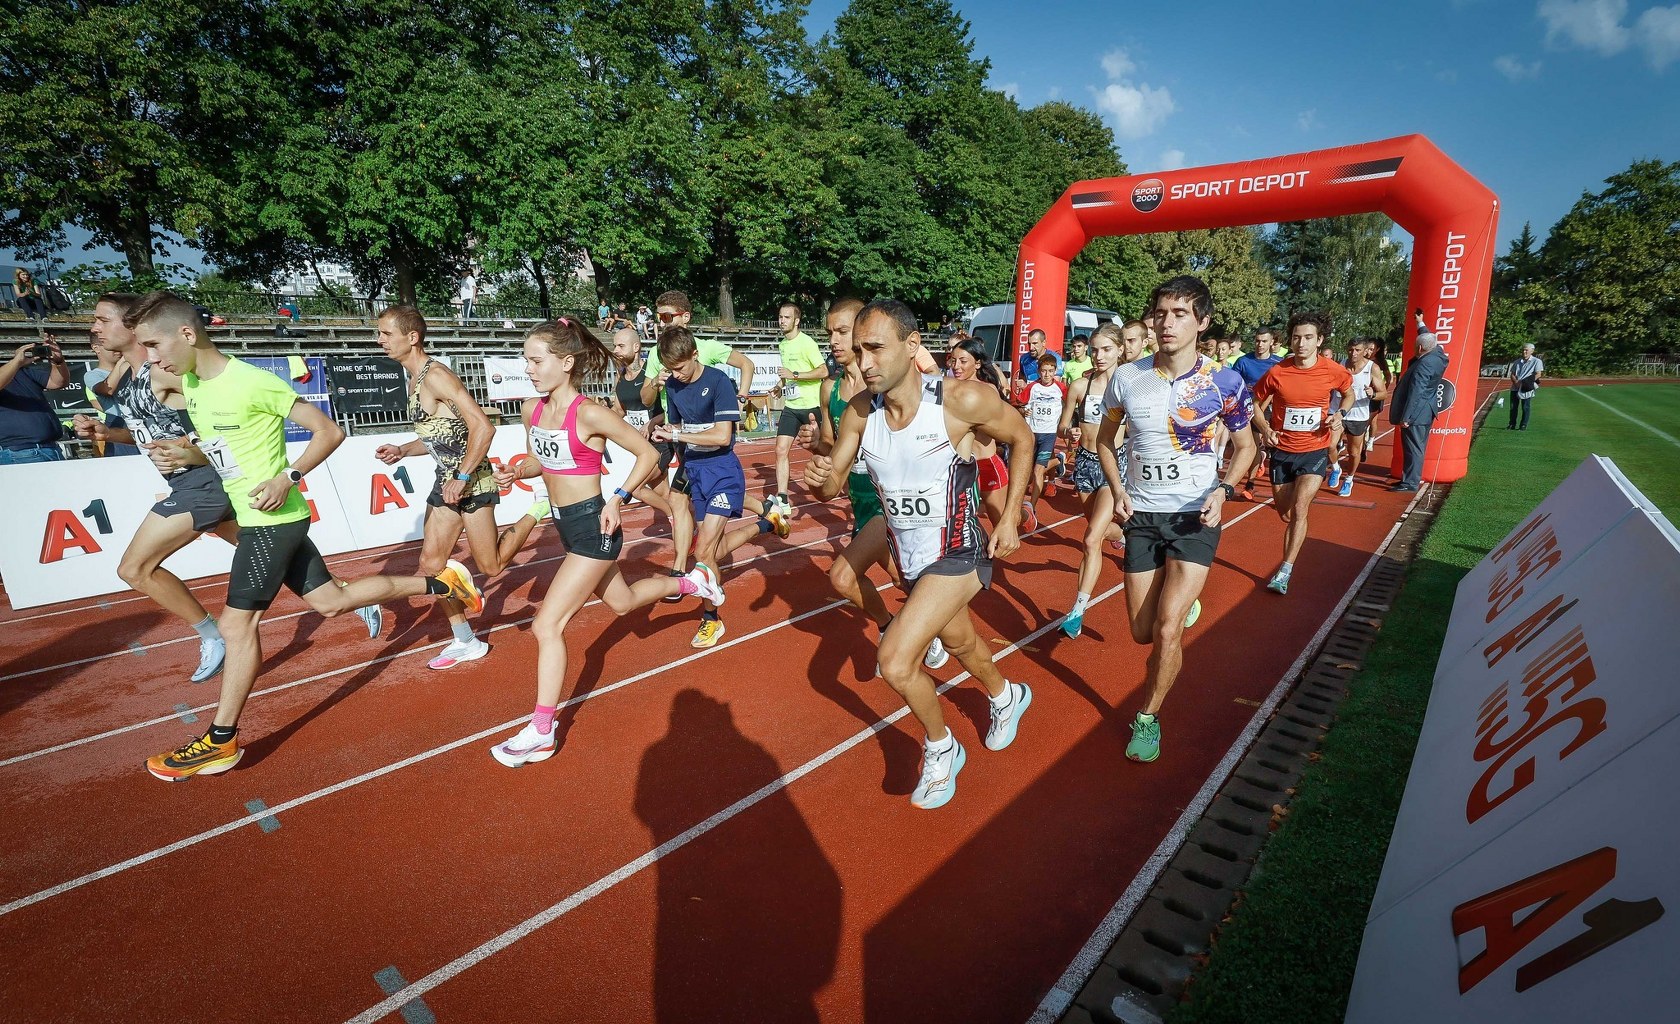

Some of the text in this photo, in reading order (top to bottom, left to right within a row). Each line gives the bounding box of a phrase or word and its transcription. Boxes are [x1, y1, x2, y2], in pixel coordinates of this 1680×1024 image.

[1135, 186, 1162, 195] SPORT
[1170, 171, 1310, 200] SPORT DEPOT
[1136, 194, 1158, 203] 2000
[1435, 231, 1466, 357] PORT DEPOT
[1019, 260, 1035, 355] PORT DEPOT
[1036, 407, 1052, 416] 358
[1091, 403, 1101, 416] 3
[630, 416, 645, 426] 336
[1290, 415, 1314, 425] 516
[534, 438, 559, 459] 369
[1142, 464, 1180, 481] 513
[370, 465, 415, 515] A1
[710, 501, 731, 510] adidas
[886, 498, 930, 516] 350
[39, 498, 113, 564] A1
[1483, 594, 1580, 669] A1
[1451, 846, 1666, 997] A1
